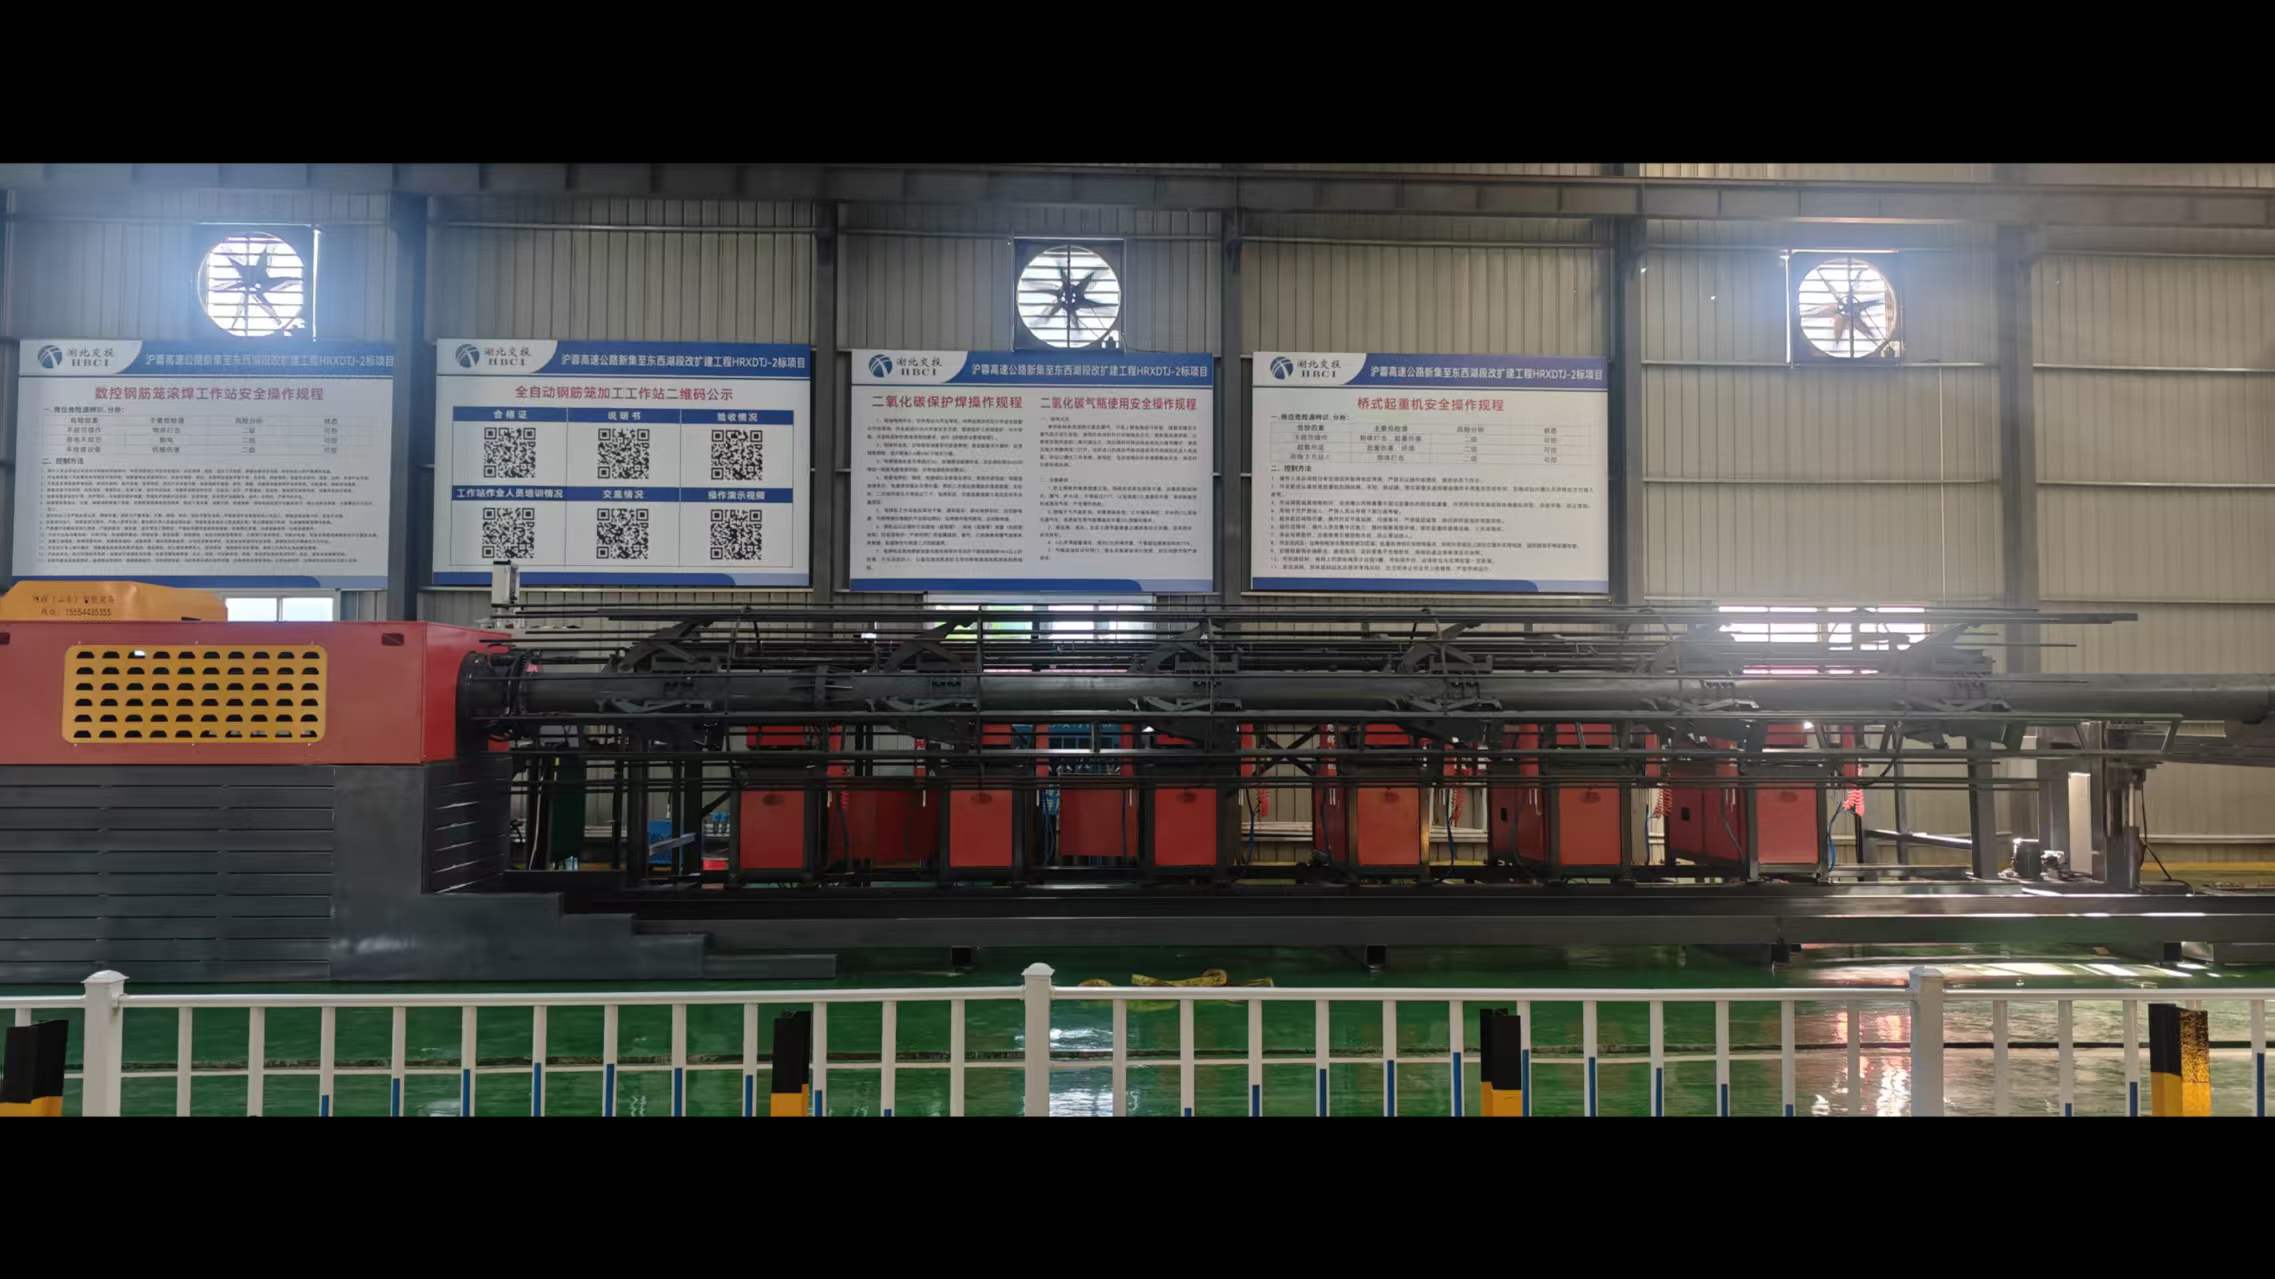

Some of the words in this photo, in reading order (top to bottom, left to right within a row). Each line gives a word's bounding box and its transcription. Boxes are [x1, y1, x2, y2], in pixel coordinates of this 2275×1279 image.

[95, 386, 324, 401] 数控钢筋笼滚焊工作站安全操作规程
[515, 385, 733, 401] 全自动钢筋笼加工工作站二维码公示
[872, 395, 1023, 409] 二氧化碳保护焊操作规程
[1357, 397, 1504, 412] 桥式起重机安全操作规程
